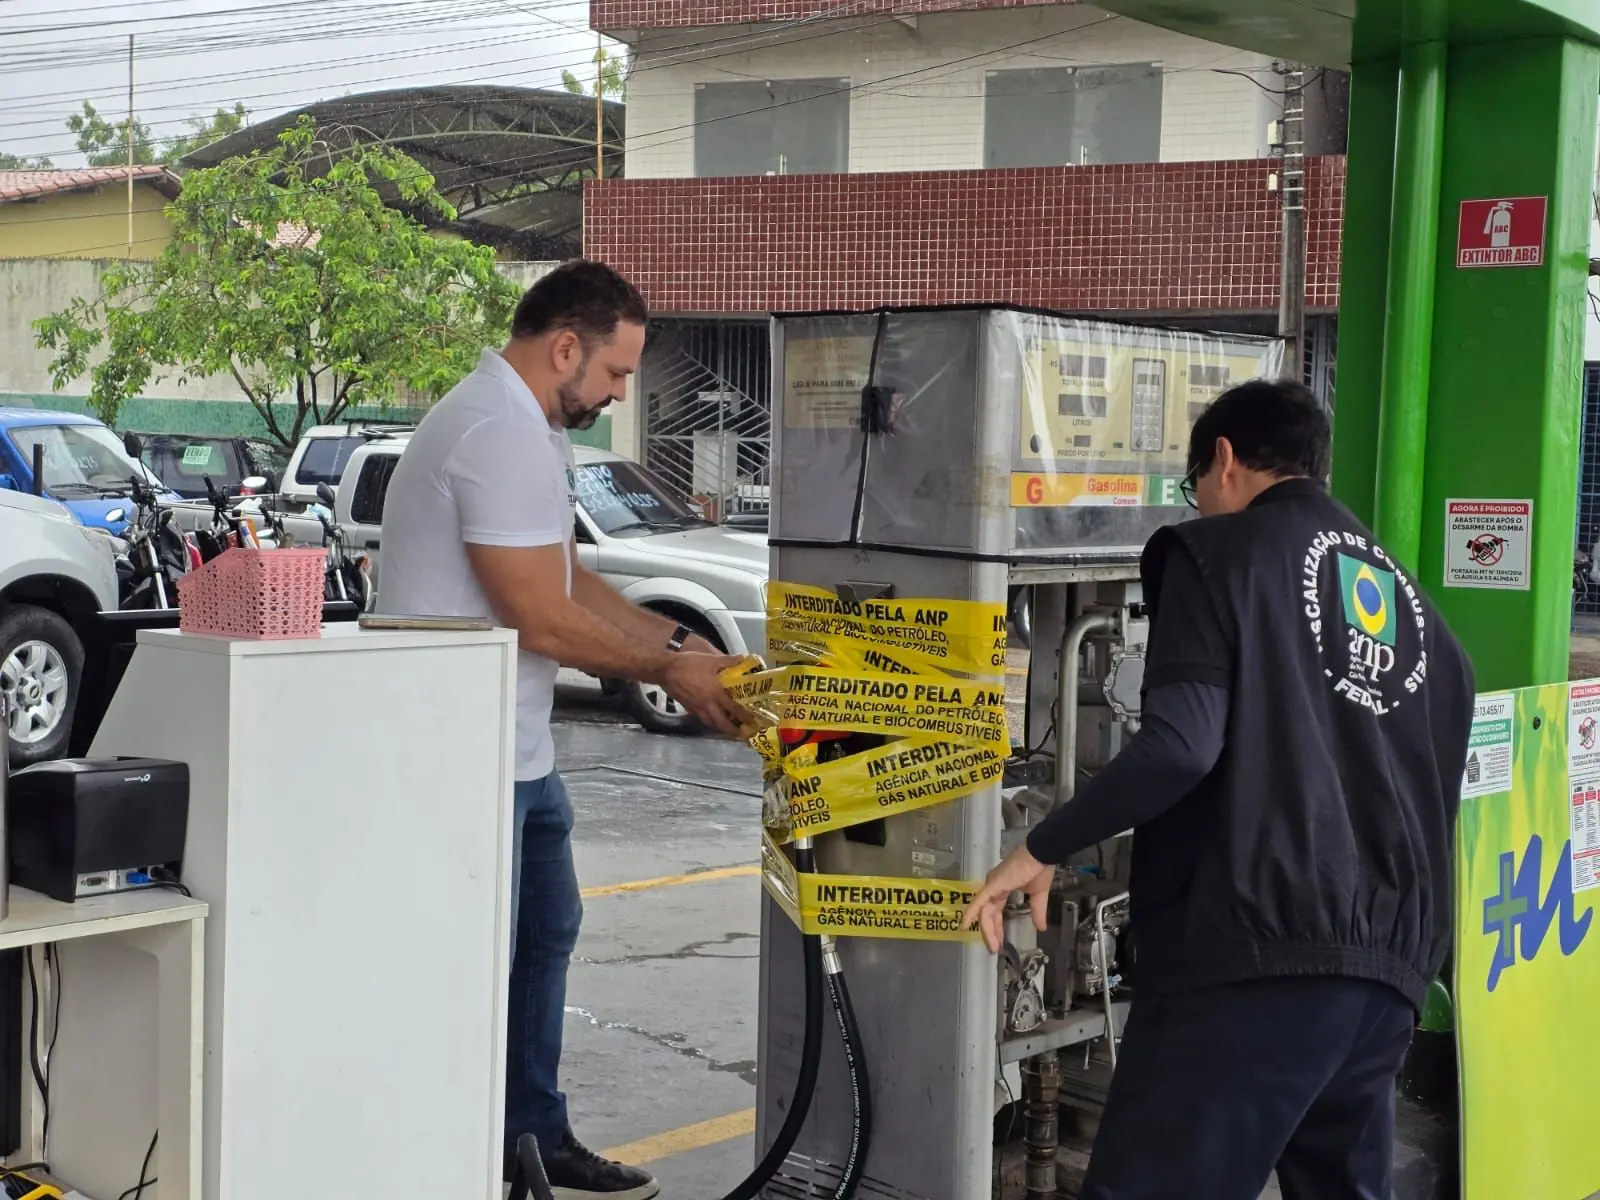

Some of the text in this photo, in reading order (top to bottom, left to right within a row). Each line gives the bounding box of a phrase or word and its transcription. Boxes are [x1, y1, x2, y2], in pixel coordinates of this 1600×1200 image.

[1494, 225, 1509, 233] ABC
[1462, 248, 1537, 263] EXTINTOR ABC
[1026, 477, 1043, 504] G
[1087, 477, 1138, 493] Gasolina
[1161, 478, 1175, 505] E
[1343, 531, 1368, 551] DE
[784, 592, 949, 627] INTERDITADO PELA ANP
[887, 626, 950, 645] PETRÓLEO,
[788, 674, 909, 699] INTERDITADO
[913, 684, 963, 704] PELA
[787, 693, 839, 709] AGÊNCIA
[844, 700, 909, 715] NACIONAL
[915, 704, 935, 715] DO
[783, 705, 1002, 742] GÁS NATURAL E BIOCOMBUSTÍVEIS
[875, 750, 999, 794] AGÊNCIA NACIONAL
[790, 776, 822, 799] ANP
[878, 791, 906, 807] GÁS
[908, 776, 969, 800] NATURAL
[969, 770, 980, 783] E
[817, 885, 944, 905] INTERDITADO
[817, 913, 846, 926] GÁS
[852, 915, 910, 930] NATURAL
[913, 918, 922, 930] E
